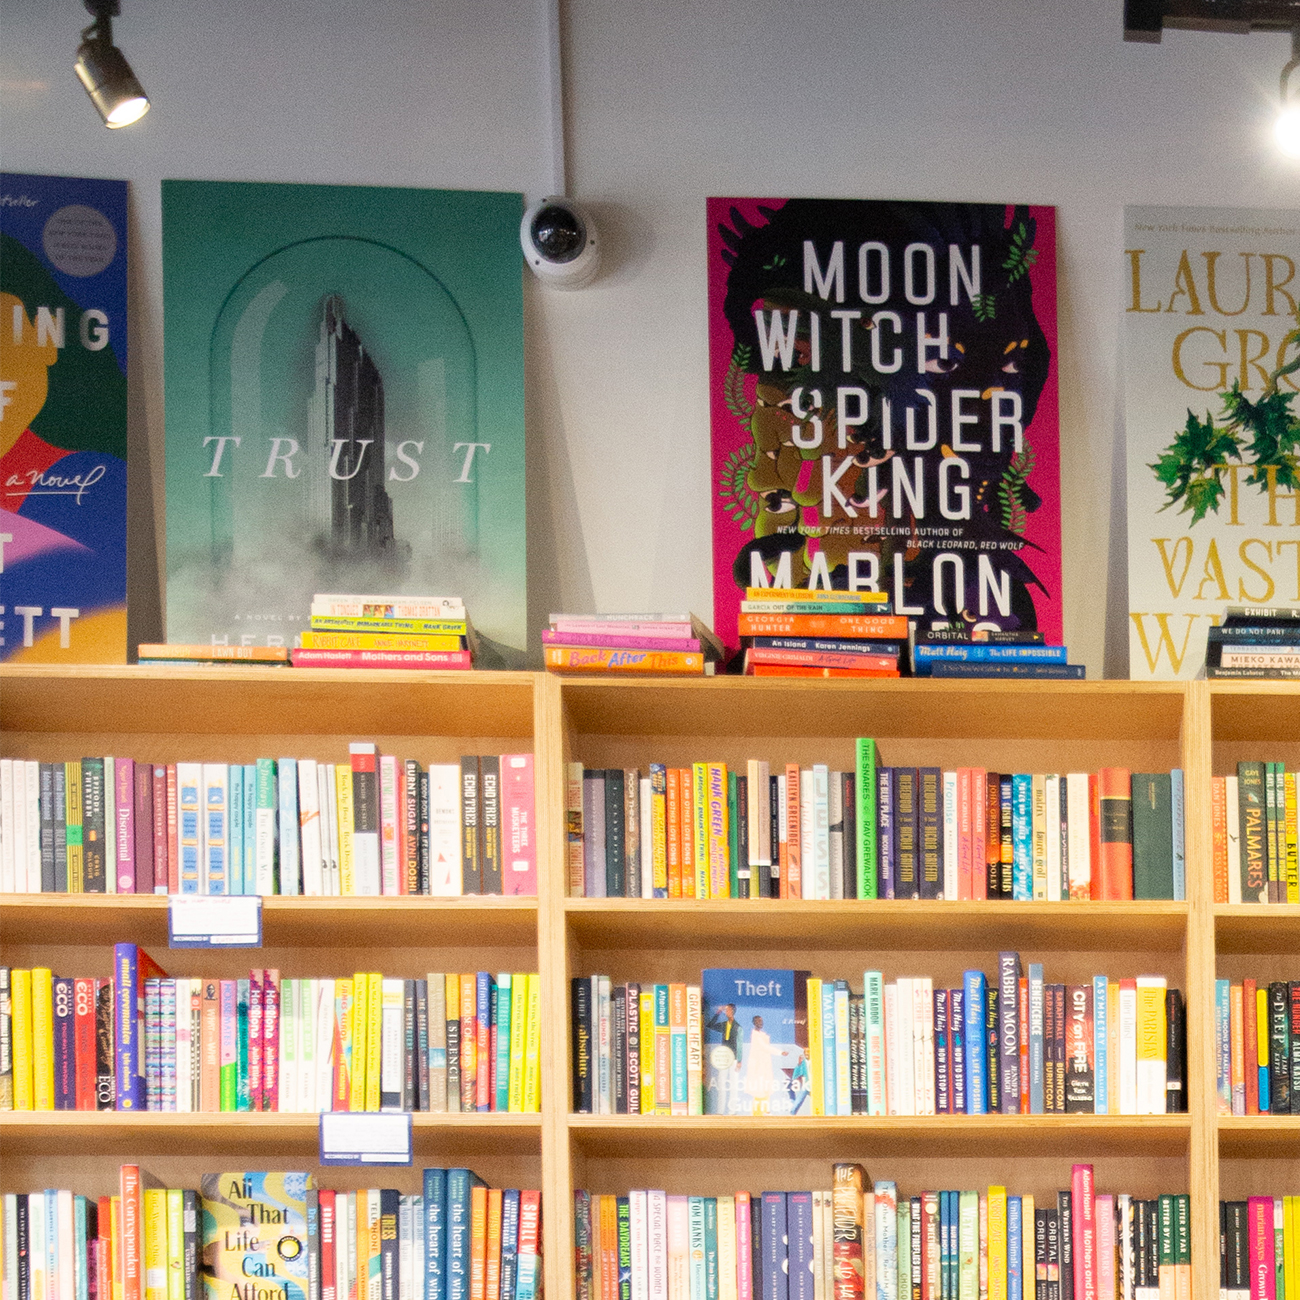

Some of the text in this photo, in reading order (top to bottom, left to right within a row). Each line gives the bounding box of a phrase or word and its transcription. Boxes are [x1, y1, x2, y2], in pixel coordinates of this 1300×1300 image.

[803, 240, 981, 306] MOON
[754, 309, 948, 374] WITCH
[791, 387, 1023, 453] SPIDER
[202, 435, 491, 484] TRUST
[821, 455, 971, 520] KING
[777, 526, 964, 537] NEW YORK TIMES BESTSELLING AUTHOR OF
[906, 540, 1024, 551] BLACK LEOPARD, RED WOLF
[751, 551, 1011, 616] MARLON
[927, 631, 968, 640] ORBITAL
[1245, 609, 1276, 617] EXHIBIT
[569, 651, 679, 667] Back After This
[119, 808, 131, 860] Disoriental
[408, 764, 418, 891] BURNT SUGAR AVNI DOSHI
[1246, 809, 1261, 887] PALMARES
[121, 959, 132, 1044] small ceremonies
[735, 980, 782, 997] Theft
[1003, 958, 1017, 1056] RABBIT MOON
[1096, 982, 1105, 1044] ASYMMETRY
[448, 1026, 458, 1083] SILENCE
[689, 994, 701, 1066] GRAVEL HEART
[1073, 992, 1086, 1072] CITY on FIRE
[125, 1175, 139, 1278] The Correspondent
[247, 1204, 289, 1224] That
[452, 1204, 463, 1223] the
[224, 1231, 259, 1251] Life
[242, 1256, 276, 1277] Can
[452, 1226, 464, 1259] heart
[453, 1262, 464, 1274] of
[1258, 1265, 1267, 1294] Grown
